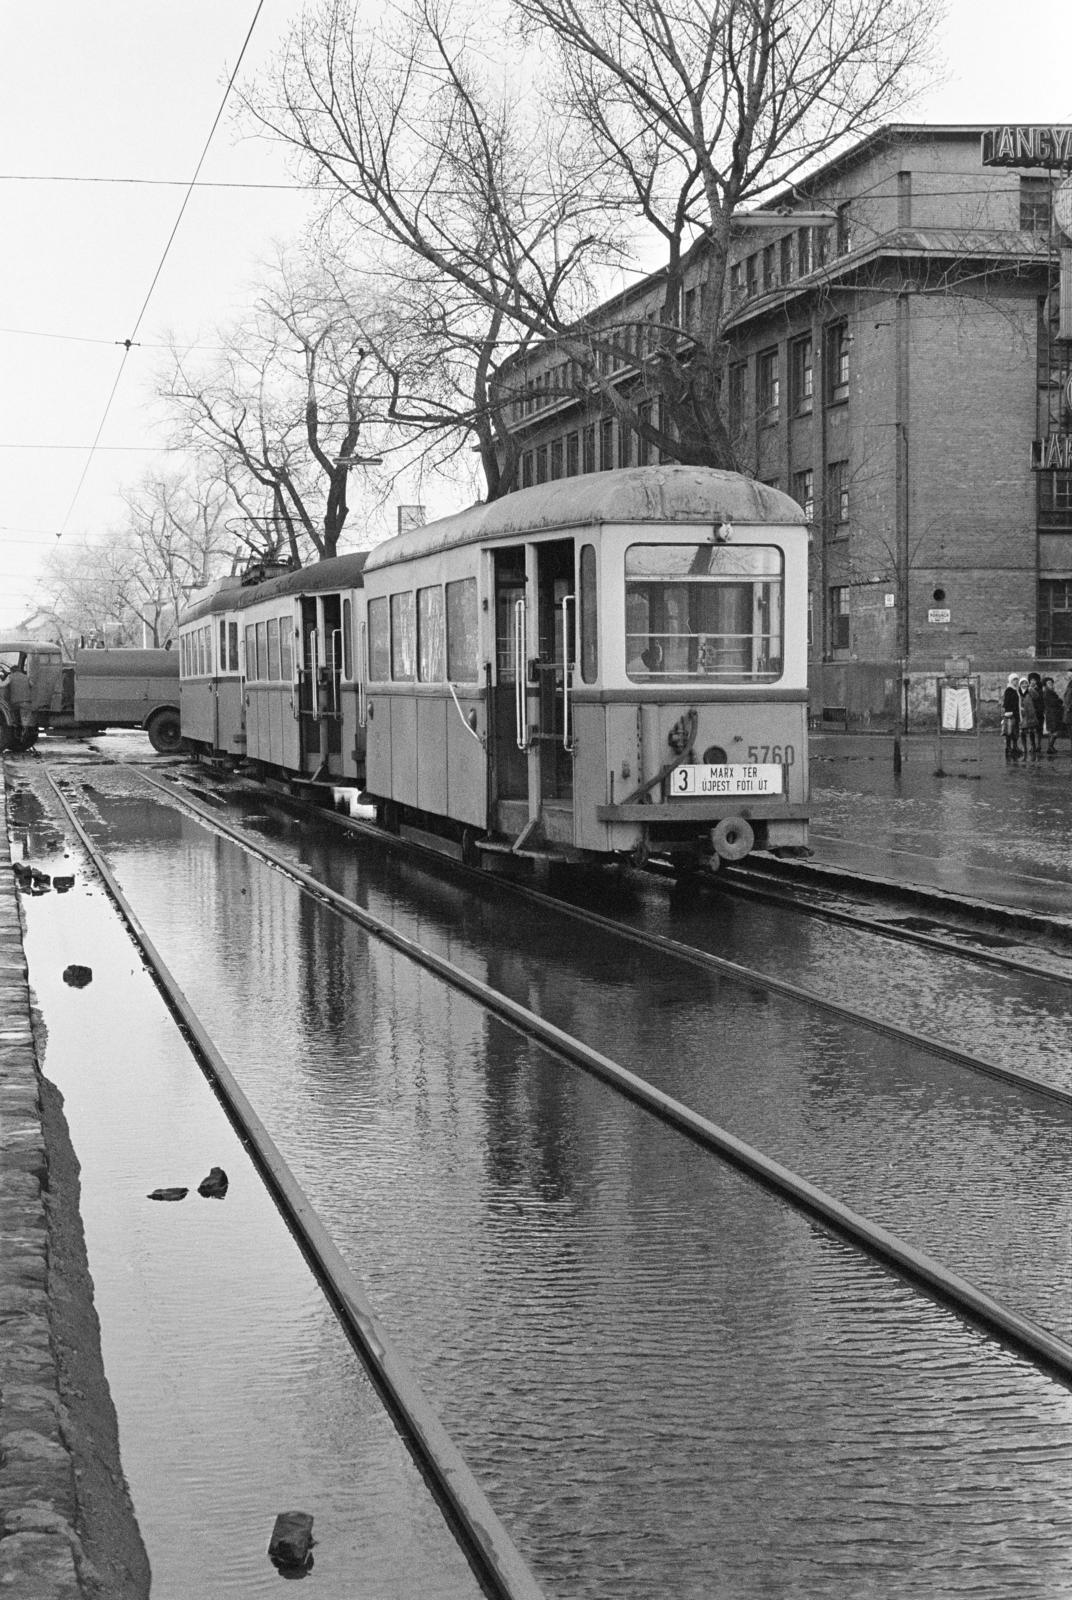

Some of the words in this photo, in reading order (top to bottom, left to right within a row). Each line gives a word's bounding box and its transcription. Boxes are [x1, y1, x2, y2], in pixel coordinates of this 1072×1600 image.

[748, 745, 795, 766] 5760
[678, 769, 688, 791] 3
[710, 767, 734, 778] MARX
